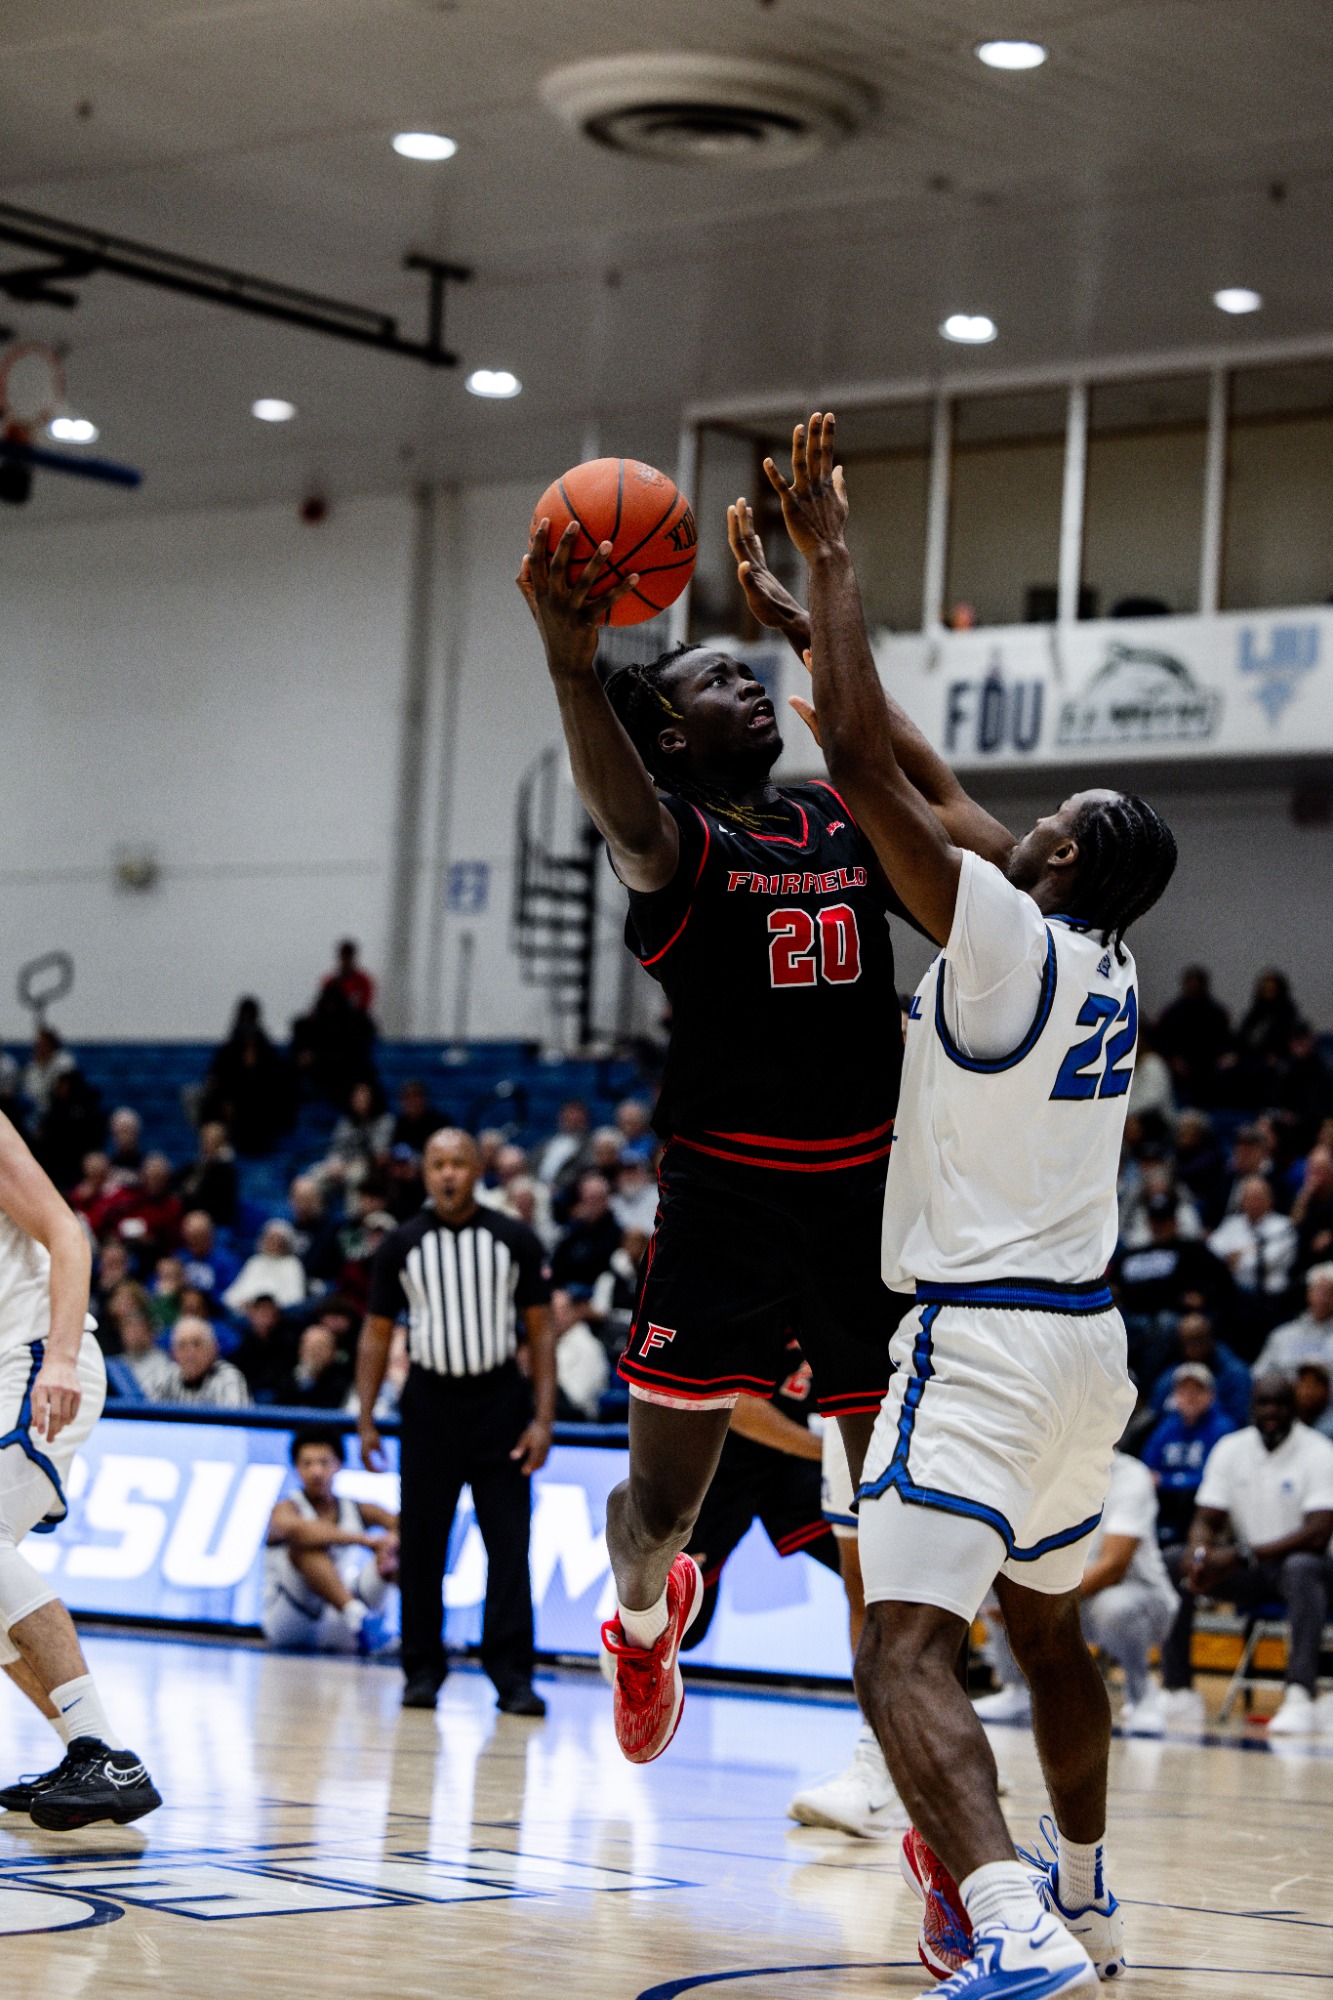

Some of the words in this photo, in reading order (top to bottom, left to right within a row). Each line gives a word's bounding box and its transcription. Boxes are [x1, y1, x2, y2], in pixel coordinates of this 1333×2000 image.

[944, 674, 1044, 753] FDU
[767, 903, 862, 988] 20
[1048, 984, 1138, 1101] 22
[639, 1321, 677, 1358] F
